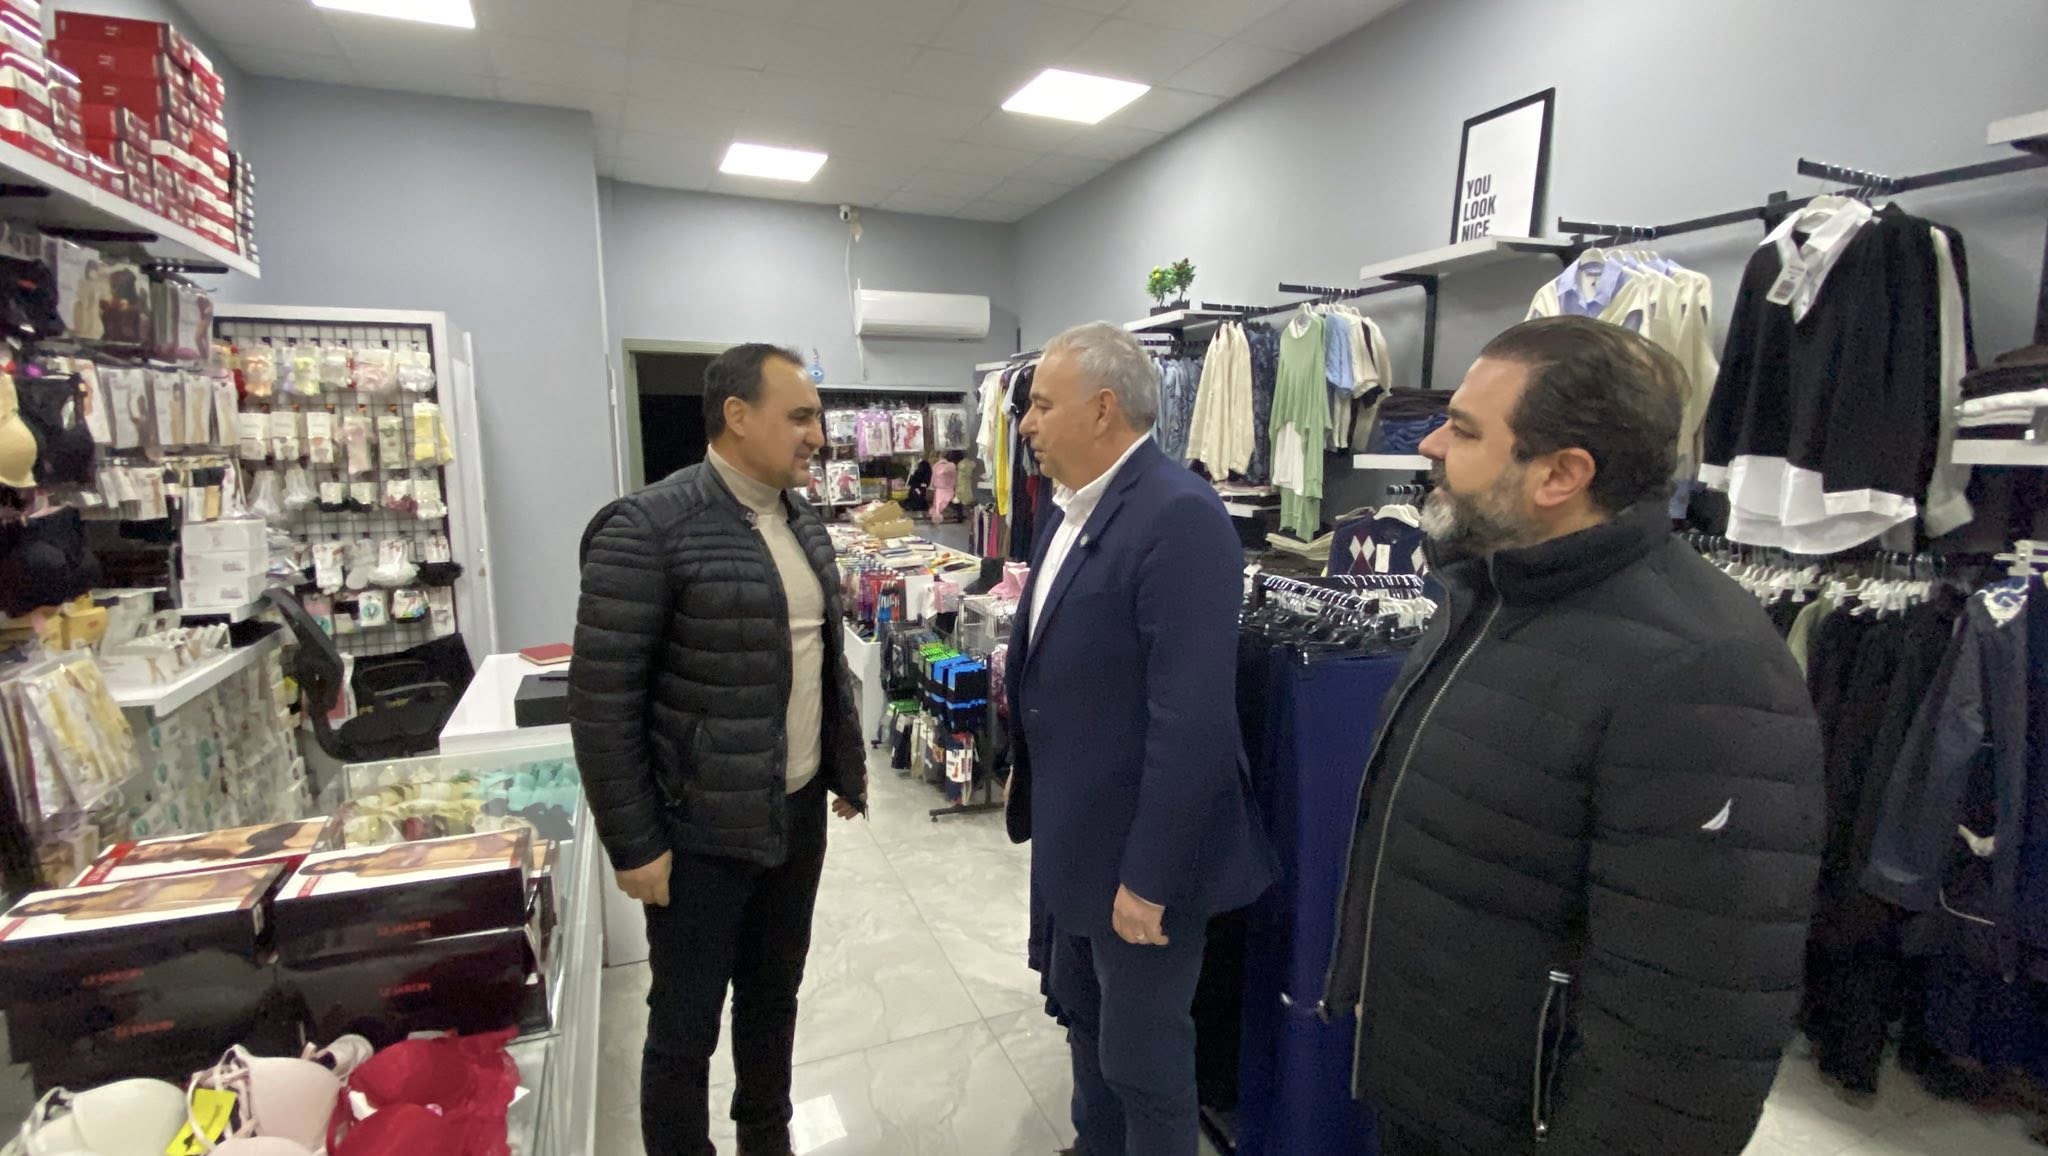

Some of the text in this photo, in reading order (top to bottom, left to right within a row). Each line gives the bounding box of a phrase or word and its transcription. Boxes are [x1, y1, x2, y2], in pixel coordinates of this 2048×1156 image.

[1467, 174, 1491, 199] YOU
[1463, 195, 1497, 222] LOOK
[1461, 219, 1490, 242] NICE
